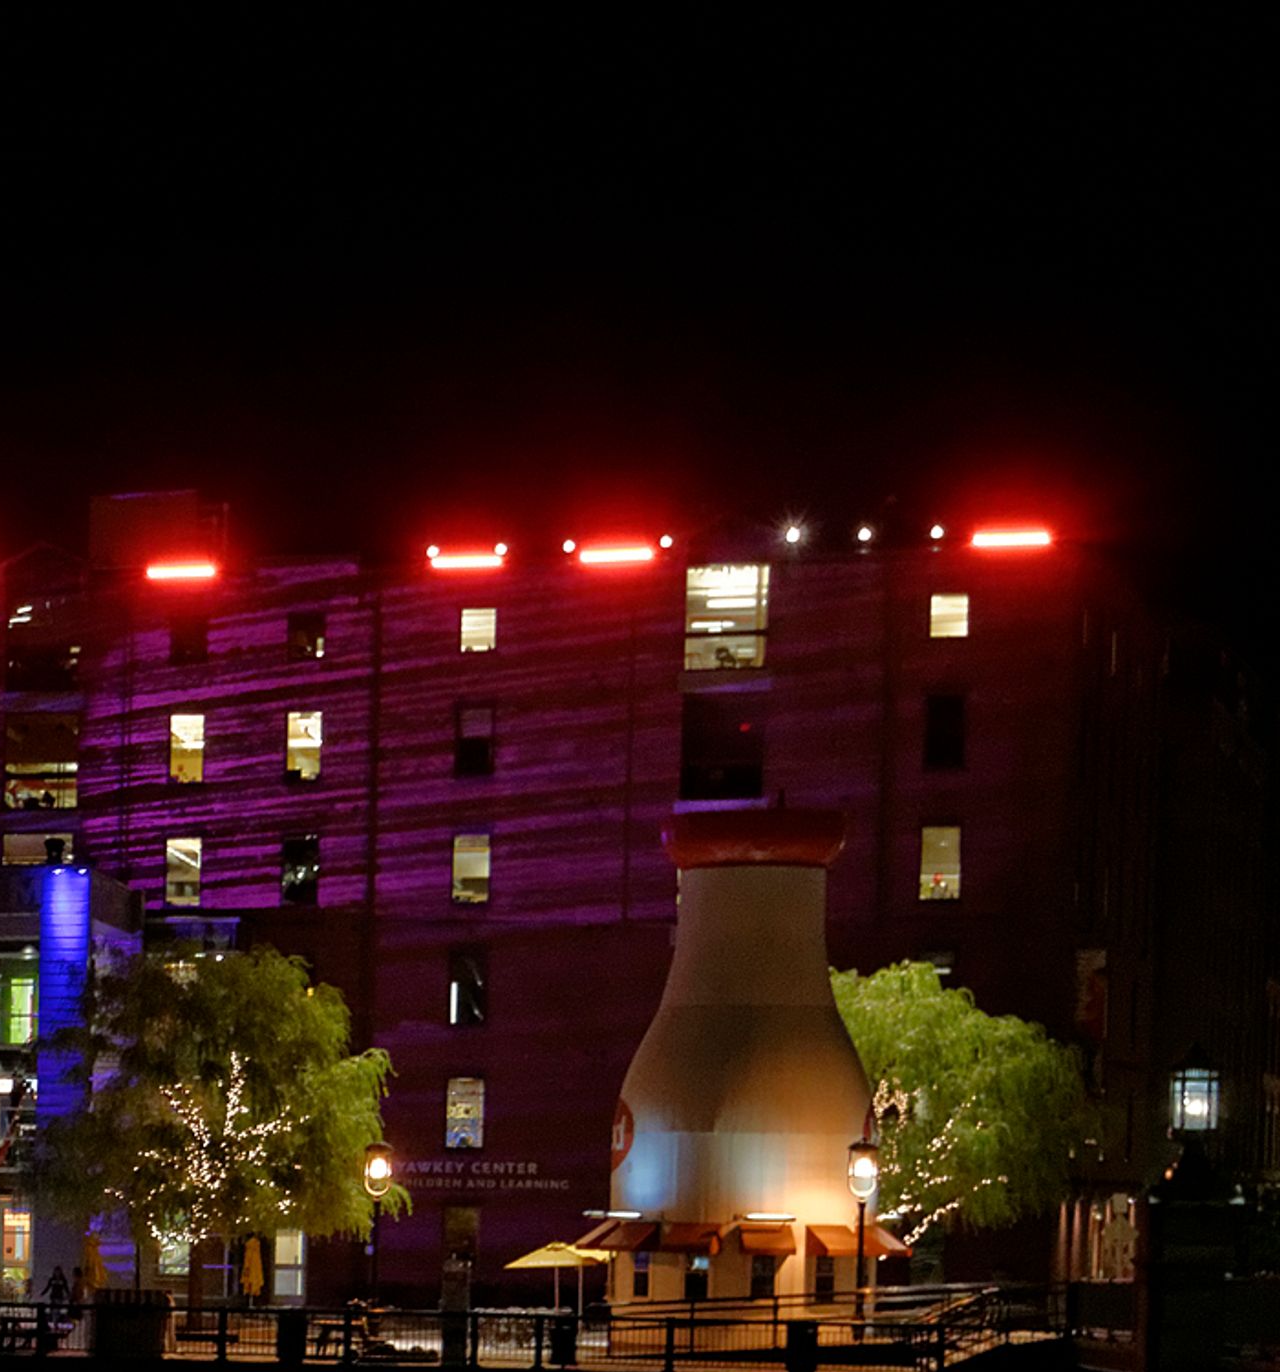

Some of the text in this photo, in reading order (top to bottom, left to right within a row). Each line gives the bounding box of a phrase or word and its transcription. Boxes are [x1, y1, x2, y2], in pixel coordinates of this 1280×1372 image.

[395, 1161, 538, 1175] YAWKEY CENTER
[466, 1179, 496, 1189] AND
[499, 1179, 570, 1191] LEARNING
